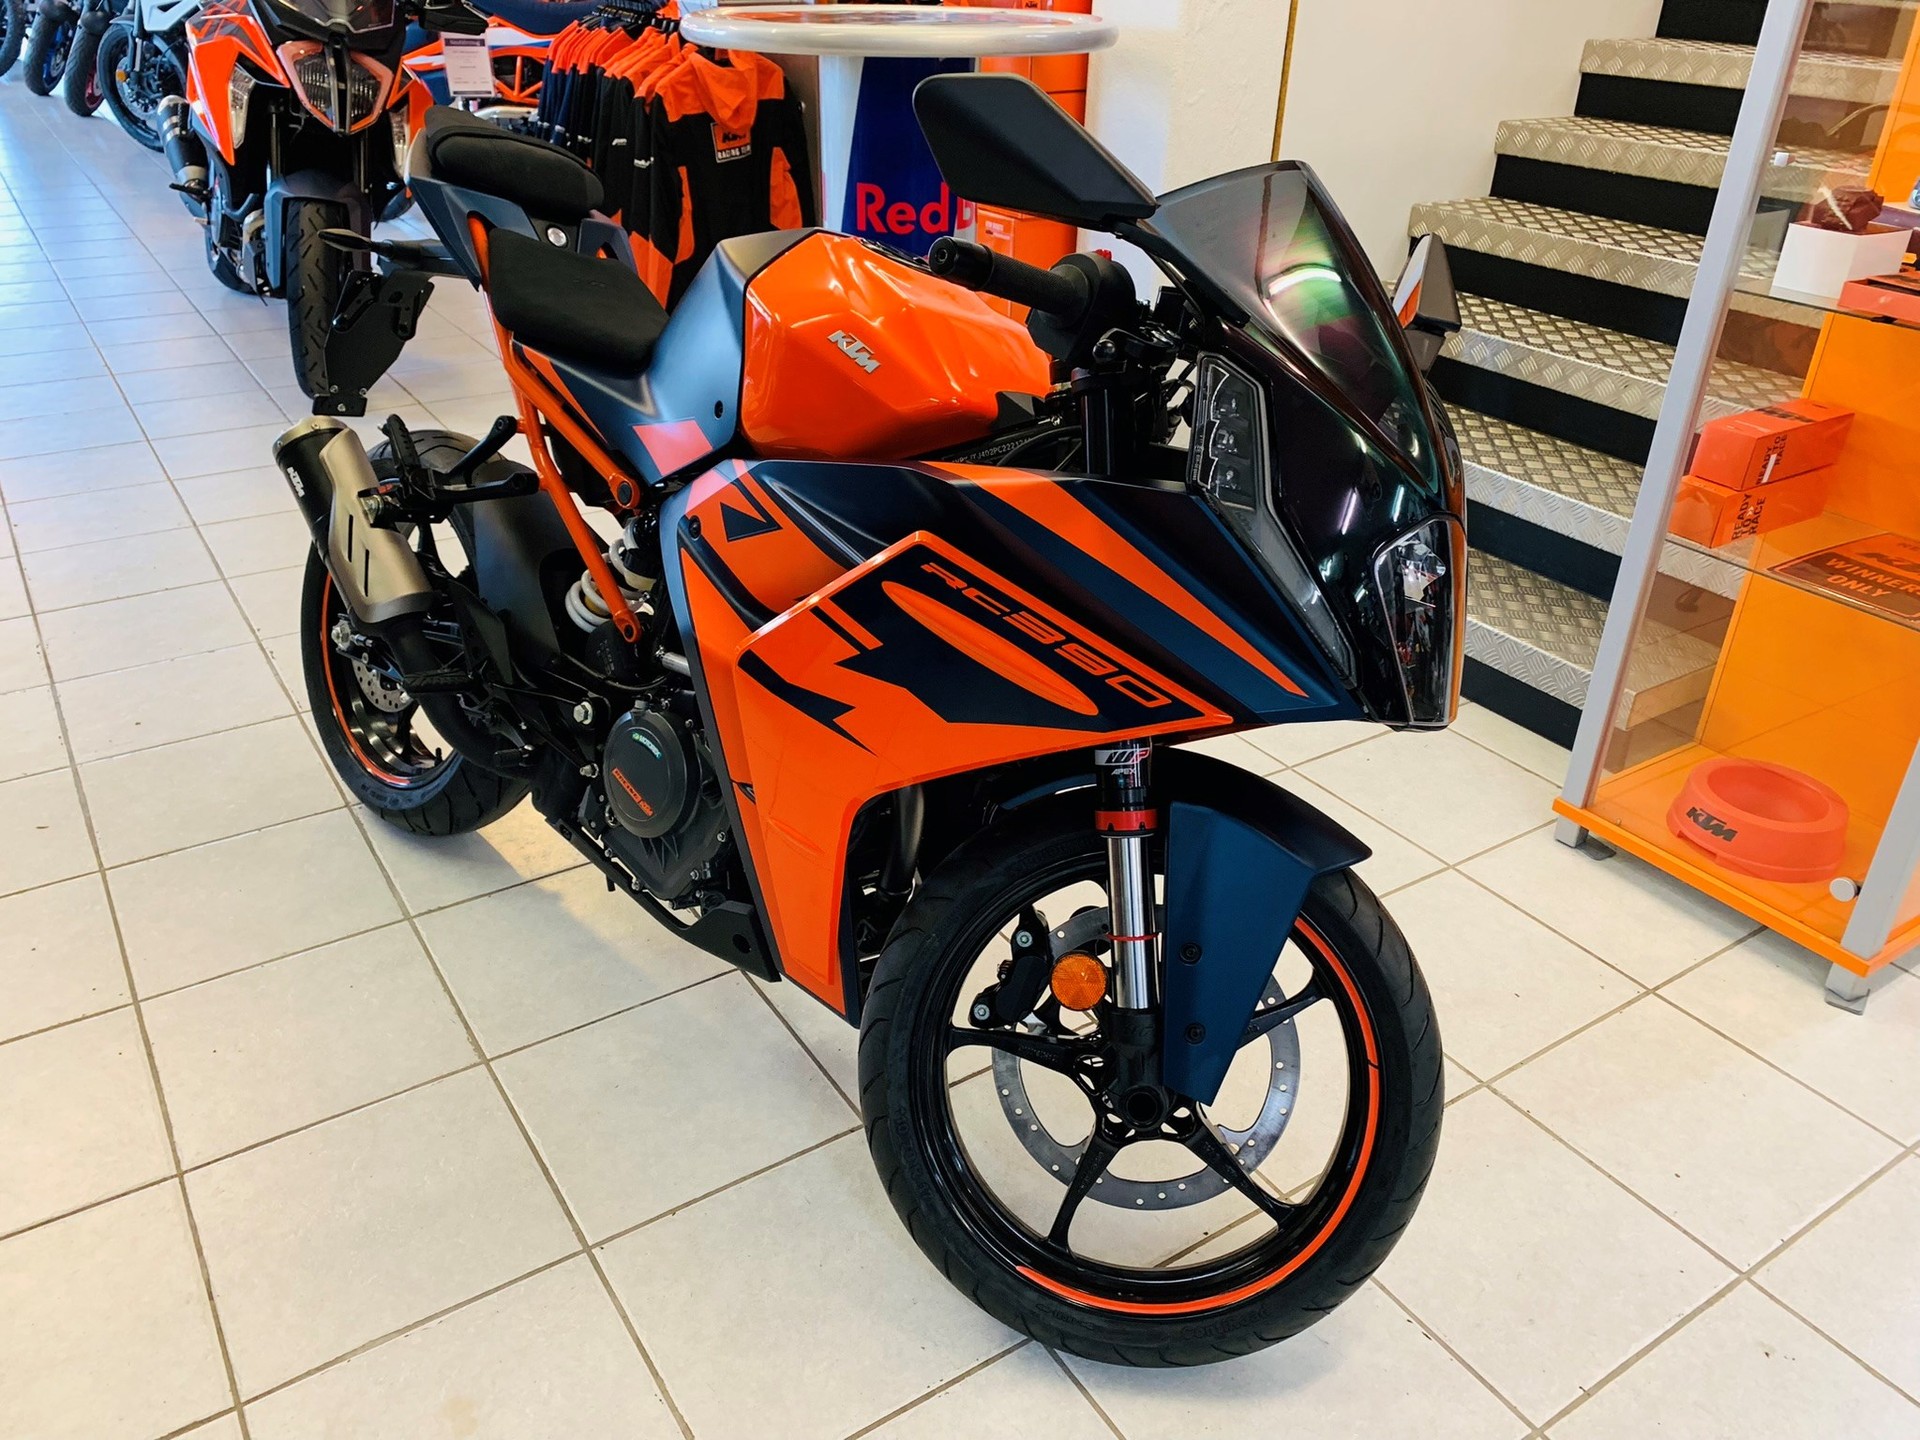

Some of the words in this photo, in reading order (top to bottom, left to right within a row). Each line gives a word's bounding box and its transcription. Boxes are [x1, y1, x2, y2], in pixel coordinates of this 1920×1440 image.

[856, 182, 949, 233] Red
[827, 329, 881, 374] KTM
[286, 466, 305, 498] KTM
[1731, 493, 1752, 541] READY
[1741, 518, 1751, 534] TO
[1748, 497, 1766, 535] RACE
[1827, 575, 1892, 597] ONLY
[1111, 767, 1136, 775] APEX
[1686, 806, 1738, 842] KTM
